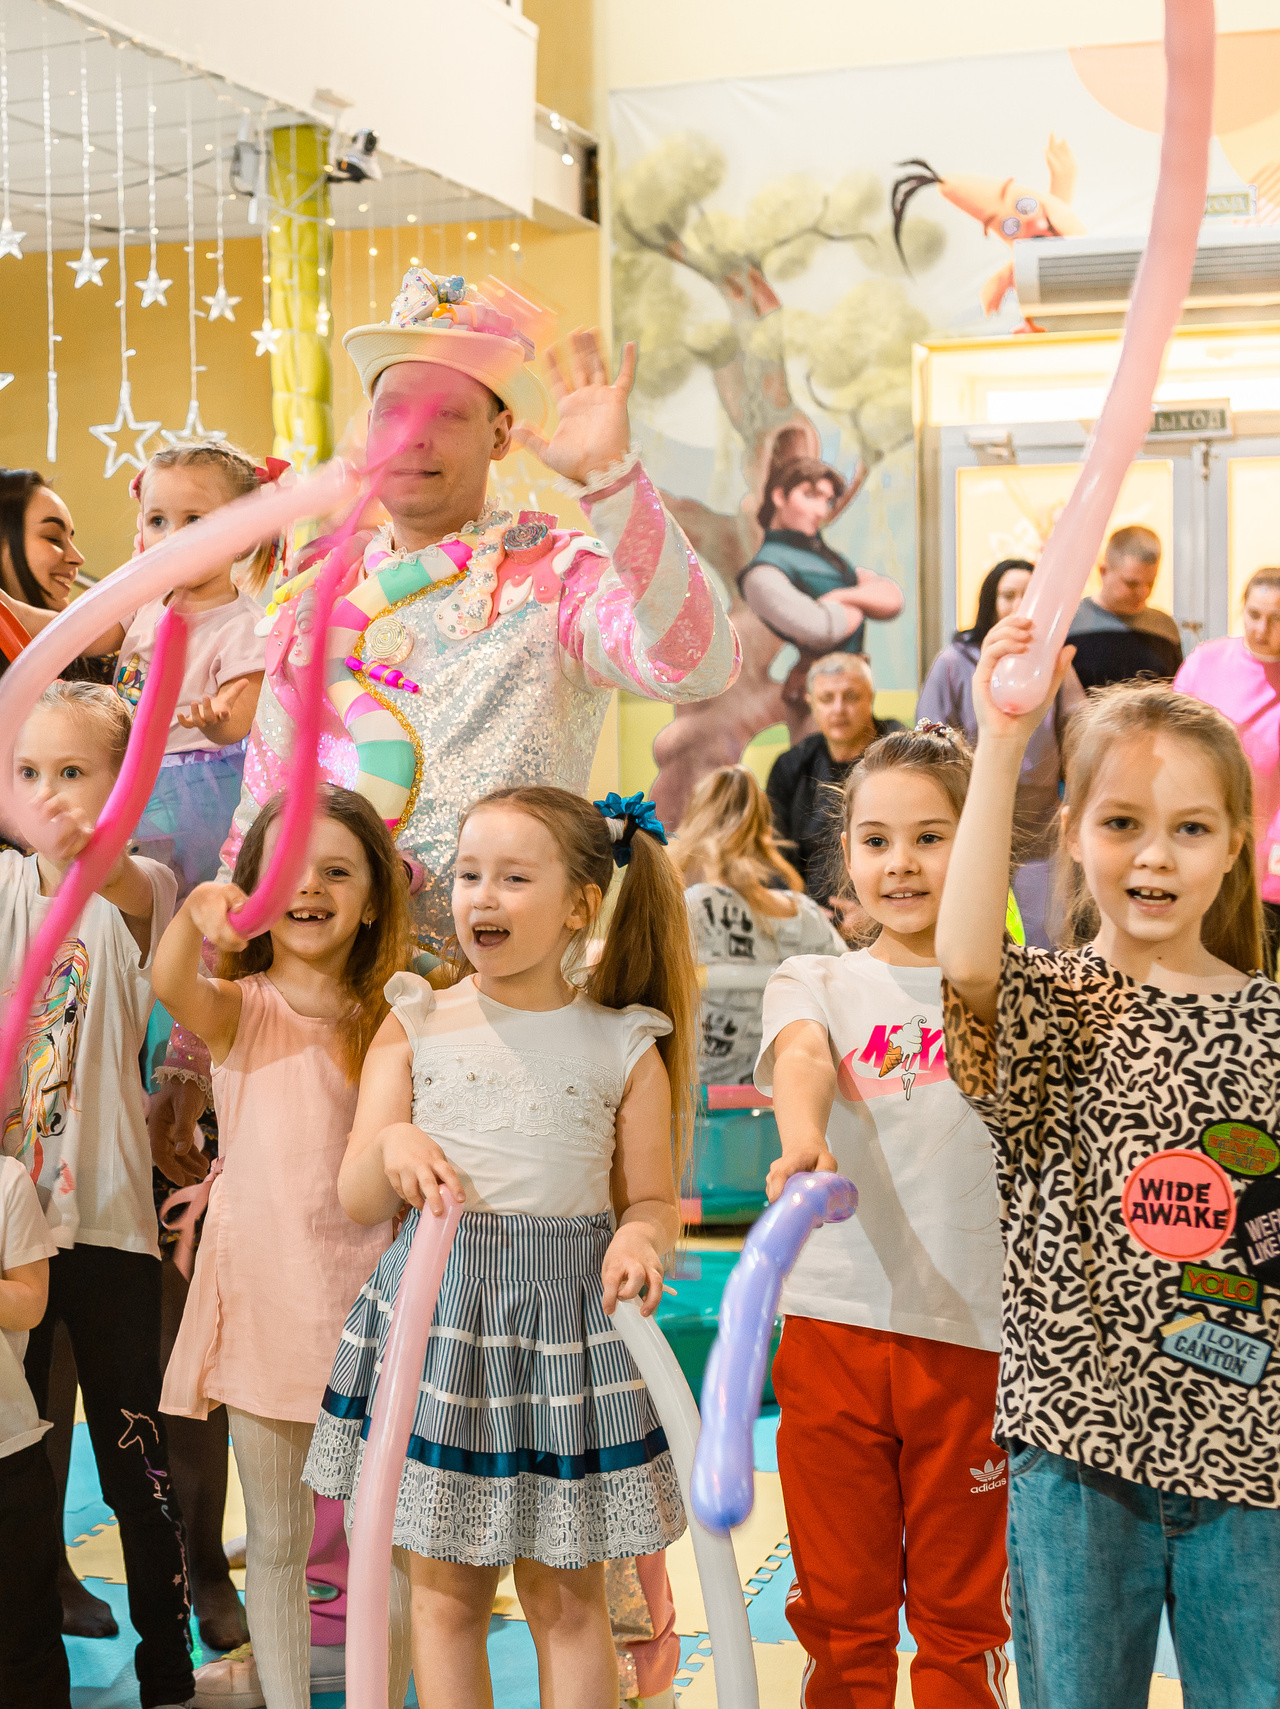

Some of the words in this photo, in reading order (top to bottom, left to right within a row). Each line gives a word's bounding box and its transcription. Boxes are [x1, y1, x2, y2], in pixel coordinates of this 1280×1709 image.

[1152, 409, 1221, 431] ЫХОД
[858, 1025, 947, 1069] NK
[1138, 1178, 1211, 1204] WIDE
[1130, 1202, 1230, 1230] AWAKE
[1187, 1270, 1254, 1300] YOLO
[1174, 1335, 1247, 1377] CANTON
[1197, 1325, 1205, 1340] I
[1209, 1327, 1260, 1360] LOVE
[970, 1477, 1007, 1494] adidas
